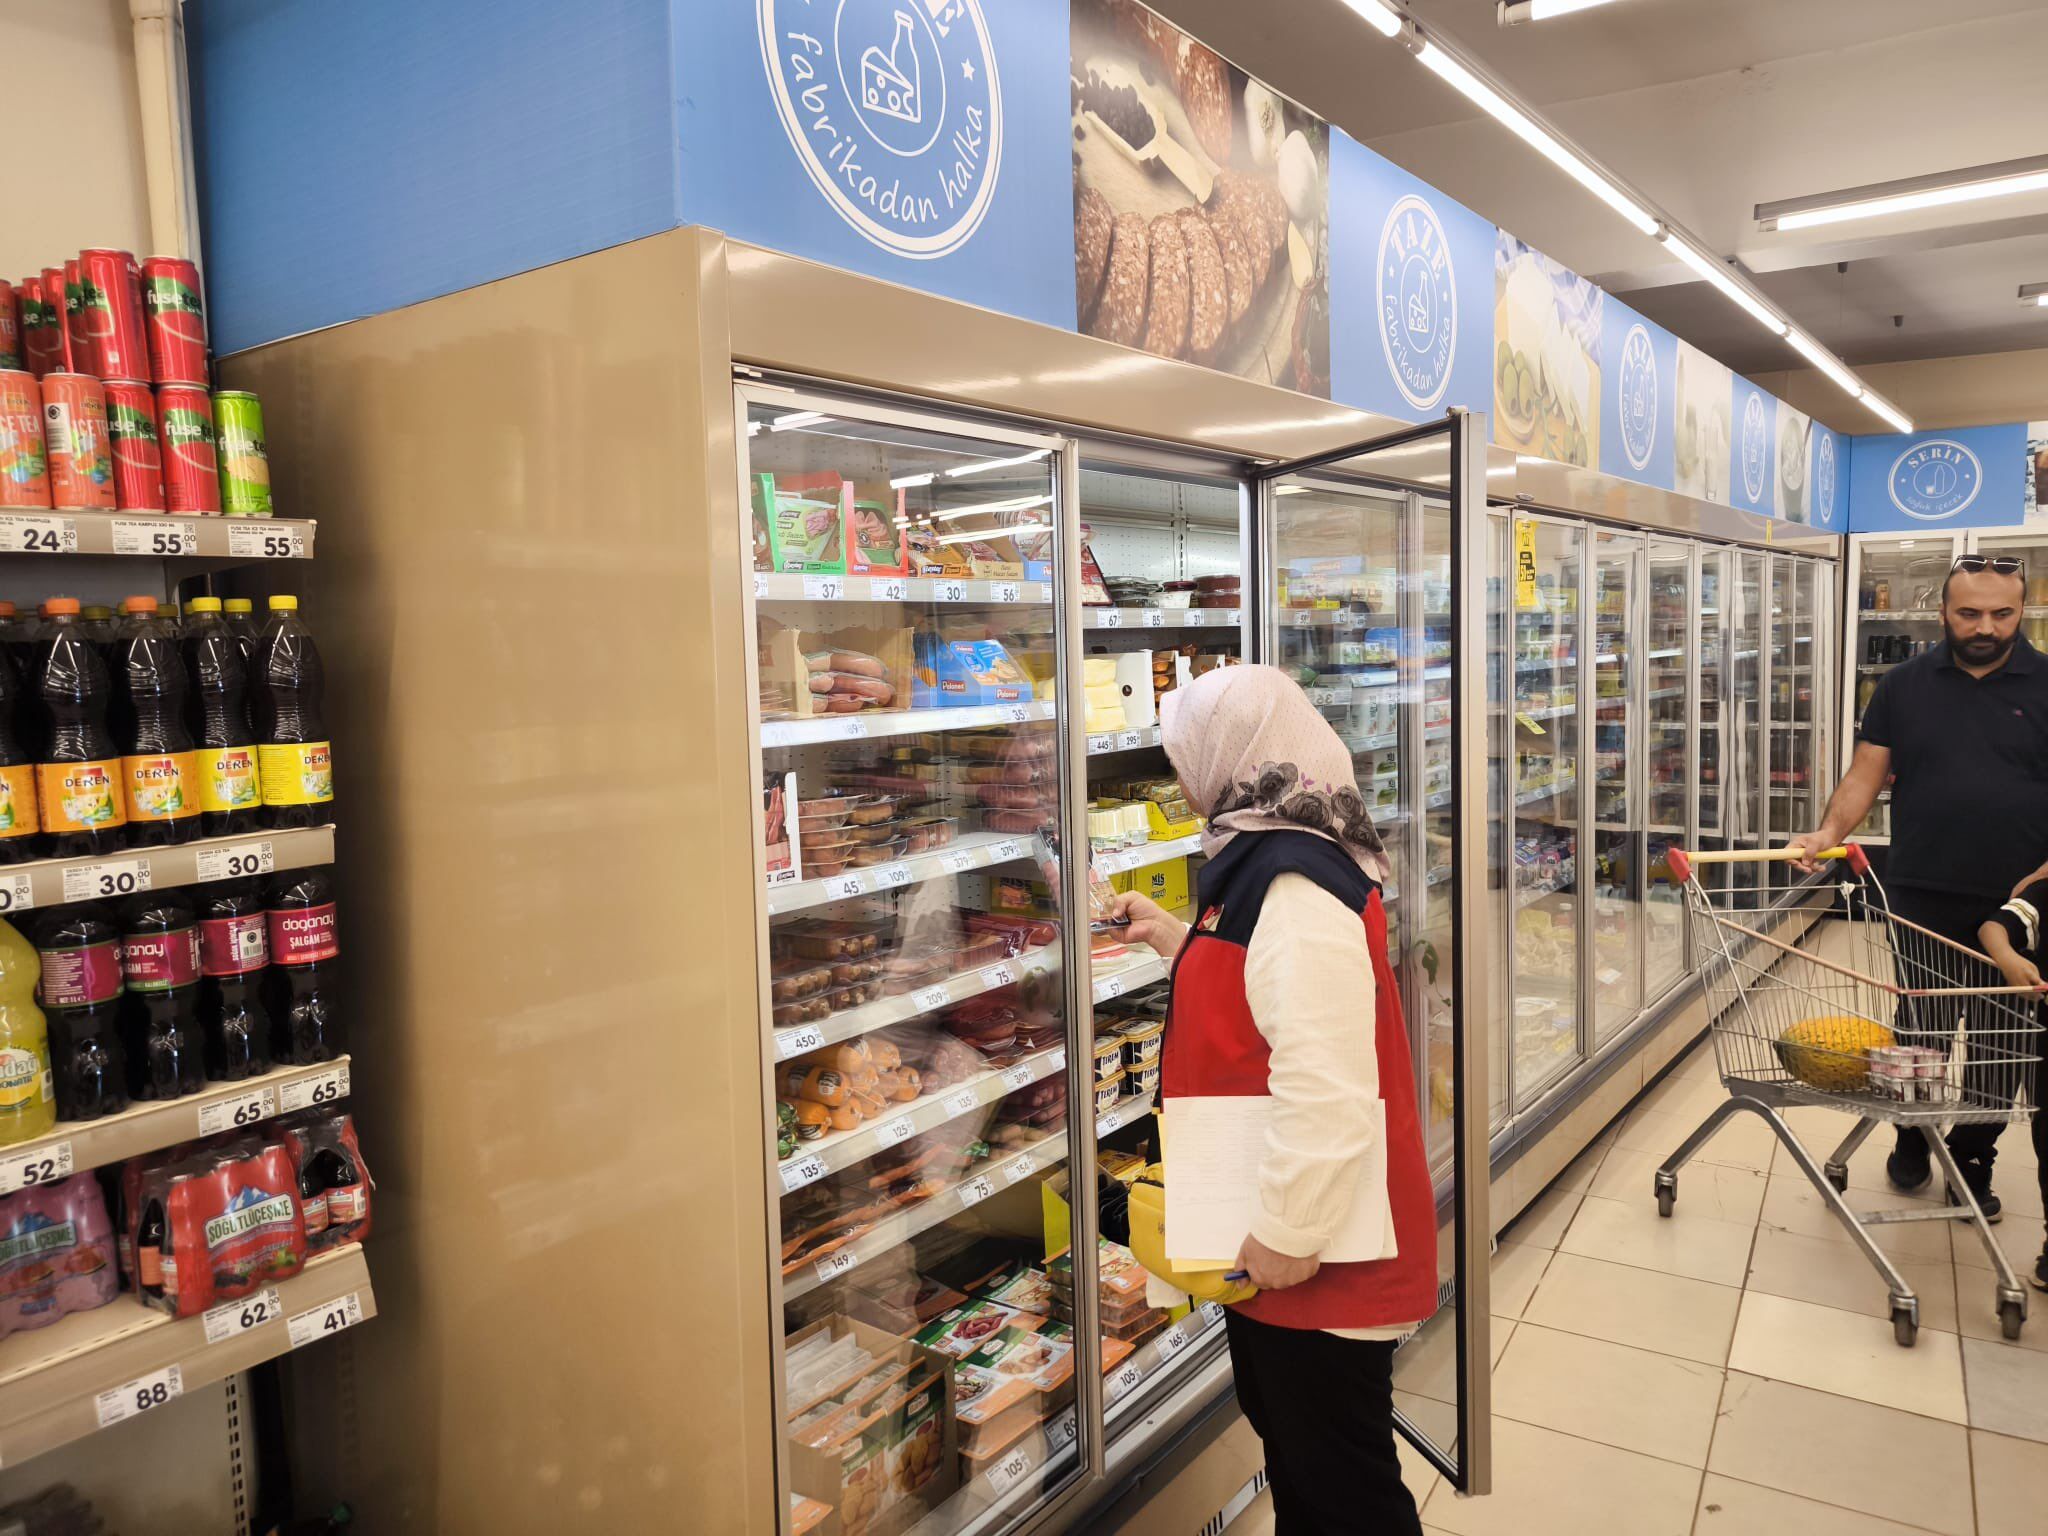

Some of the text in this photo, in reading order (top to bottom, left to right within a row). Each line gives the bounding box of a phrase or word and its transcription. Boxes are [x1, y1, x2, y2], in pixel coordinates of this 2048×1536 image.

[787, 31, 983, 223] fabrikadan halka
[1390, 212, 1446, 280] TAZE
[1385, 294, 1451, 391] fabrikadan halka
[1907, 446, 1966, 468] SERİN
[23, 528, 60, 551] 24
[152, 533, 182, 554] 55
[264, 537, 290, 557] 55
[822, 584, 836, 599] 37
[886, 586, 900, 600] 42
[946, 586, 960, 601] 30
[1003, 588, 1015, 602] 56
[1108, 615, 1118, 627] 67
[1152, 614, 1161, 626] 85
[1012, 709, 1026, 721] 35
[65, 775, 110, 788] DEREN
[136, 768, 179, 780] DEREN
[228, 854, 260, 876] 30
[99, 872, 134, 896] 30
[889, 870, 905, 882] 109
[844, 880, 860, 895] 45
[997, 972, 1010, 985] 75
[1110, 982, 1121, 995] 57
[795, 1034, 816, 1050] 450
[312, 1080, 337, 1104] 65
[234, 1101, 260, 1126] 65
[893, 1125, 908, 1138] 125
[22, 1158, 56, 1186] 52
[800, 1164, 819, 1179] 135
[974, 1184, 989, 1199] 75
[832, 1254, 850, 1270] 149
[240, 1302, 269, 1329] 62
[323, 1308, 348, 1332] 41
[1168, 1332, 1183, 1350] 165
[1120, 1370, 1136, 1388] 105
[136, 1382, 169, 1410] 88
[1004, 1458, 1024, 1480] 105
